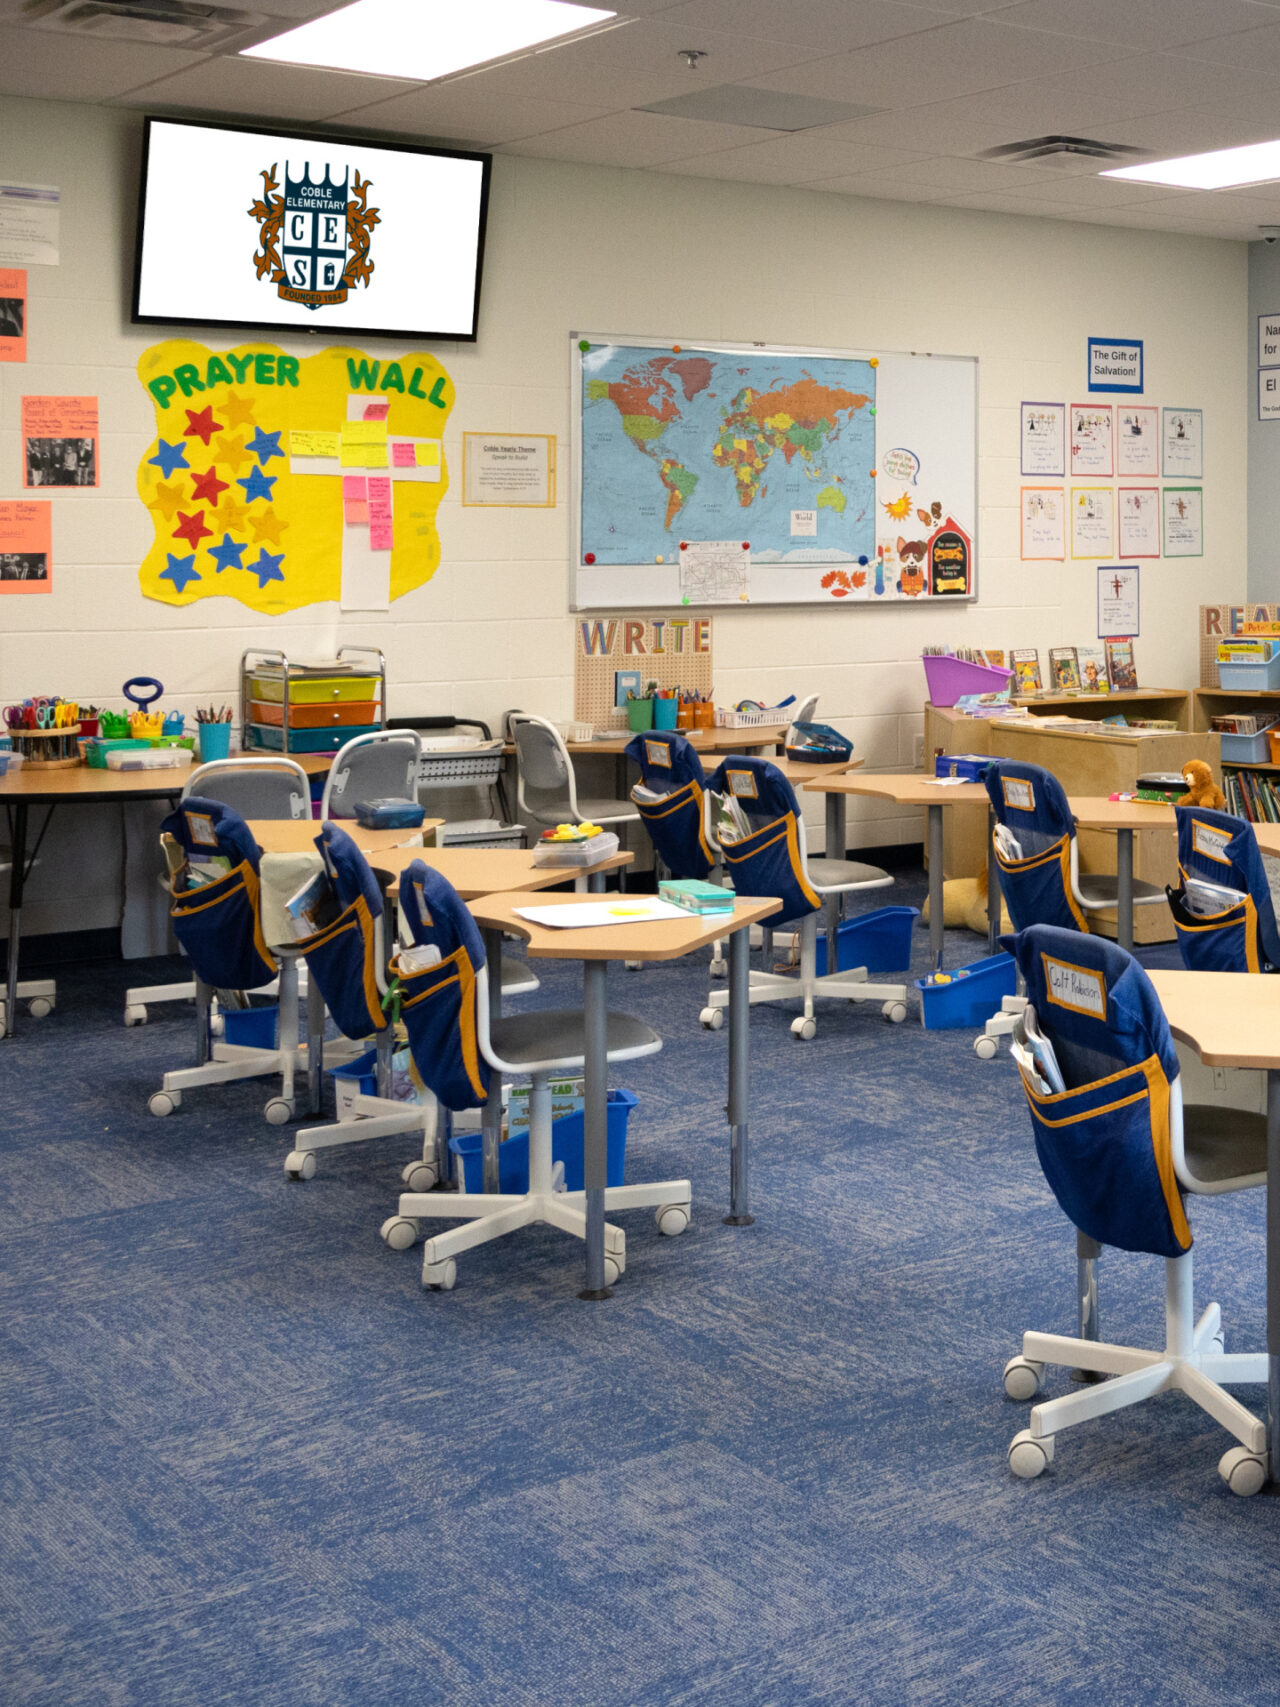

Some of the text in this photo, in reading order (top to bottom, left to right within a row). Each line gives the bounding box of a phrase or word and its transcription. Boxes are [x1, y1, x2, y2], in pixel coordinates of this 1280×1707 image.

[300, 186, 333, 199] COBLE
[286, 197, 346, 211] ELEMENTARY
[291, 214, 338, 243] C E
[292, 259, 307, 286] S
[283, 288, 322, 302] FOUNDED
[1093, 350, 1138, 362] The Gift of
[1264, 343, 1277, 355] for
[1094, 365, 1136, 377] Salvation!
[148, 353, 447, 409] PRAYER WALL
[1266, 379, 1276, 392] El
[581, 619, 710, 656] WRITE
